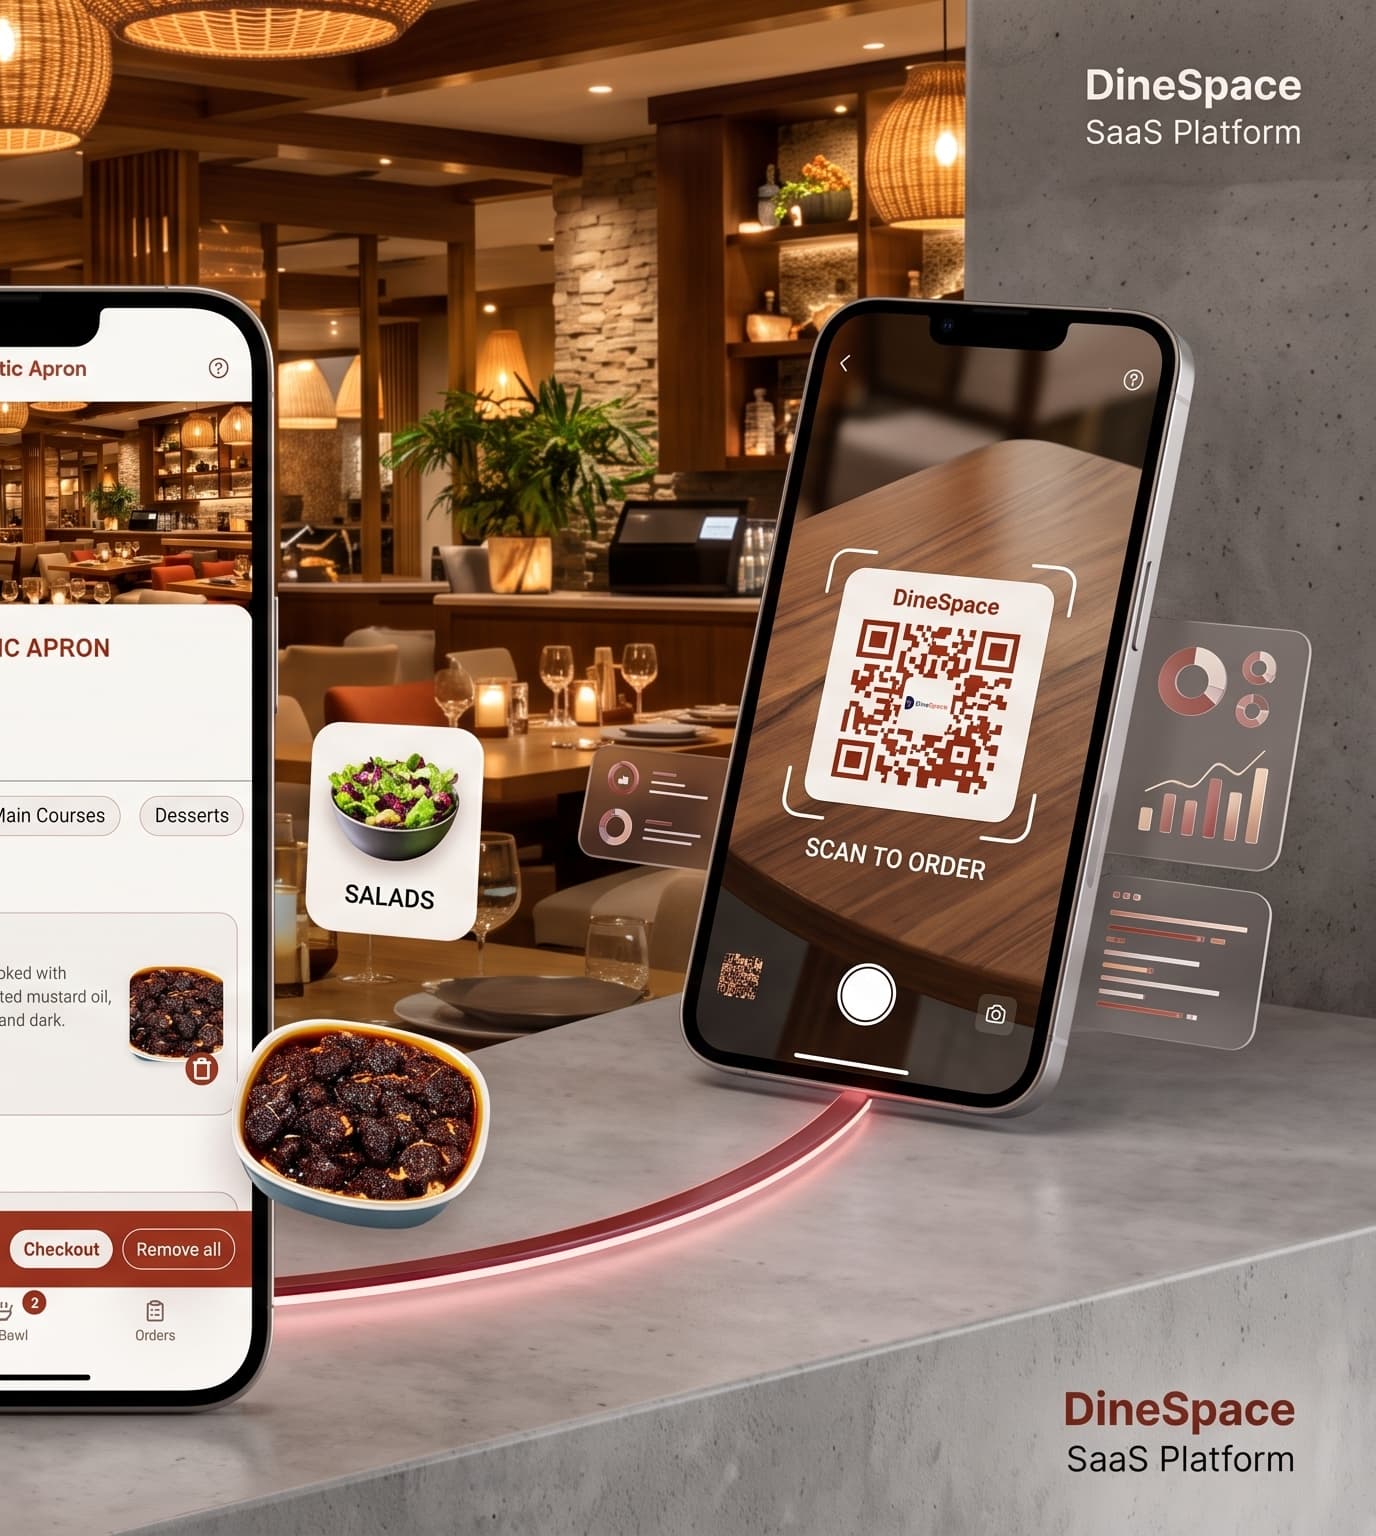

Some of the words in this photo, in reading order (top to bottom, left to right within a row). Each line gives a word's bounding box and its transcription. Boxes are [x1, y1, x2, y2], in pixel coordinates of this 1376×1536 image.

[28, 360, 87, 380] Apron
[892, 588, 1000, 616] DineSpace
[26, 638, 110, 657] APRON
[37, 807, 106, 823] Courses
[155, 807, 229, 823] Desserts
[805, 836, 866, 865] SCAN
[873, 844, 903, 869] TO
[908, 849, 986, 881] ORDER
[345, 884, 435, 909] SALADS
[36, 966, 66, 980] with
[27, 989, 87, 1003] mustard
[91, 989, 112, 1006] oil,
[29, 1013, 65, 1027] dark.
[24, 1241, 100, 1257] Checkout
[137, 1242, 199, 1257] Remove
[202, 1241, 221, 1257] all
[32, 1298, 39, 1309] 2
[135, 1330, 176, 1341] Orders
